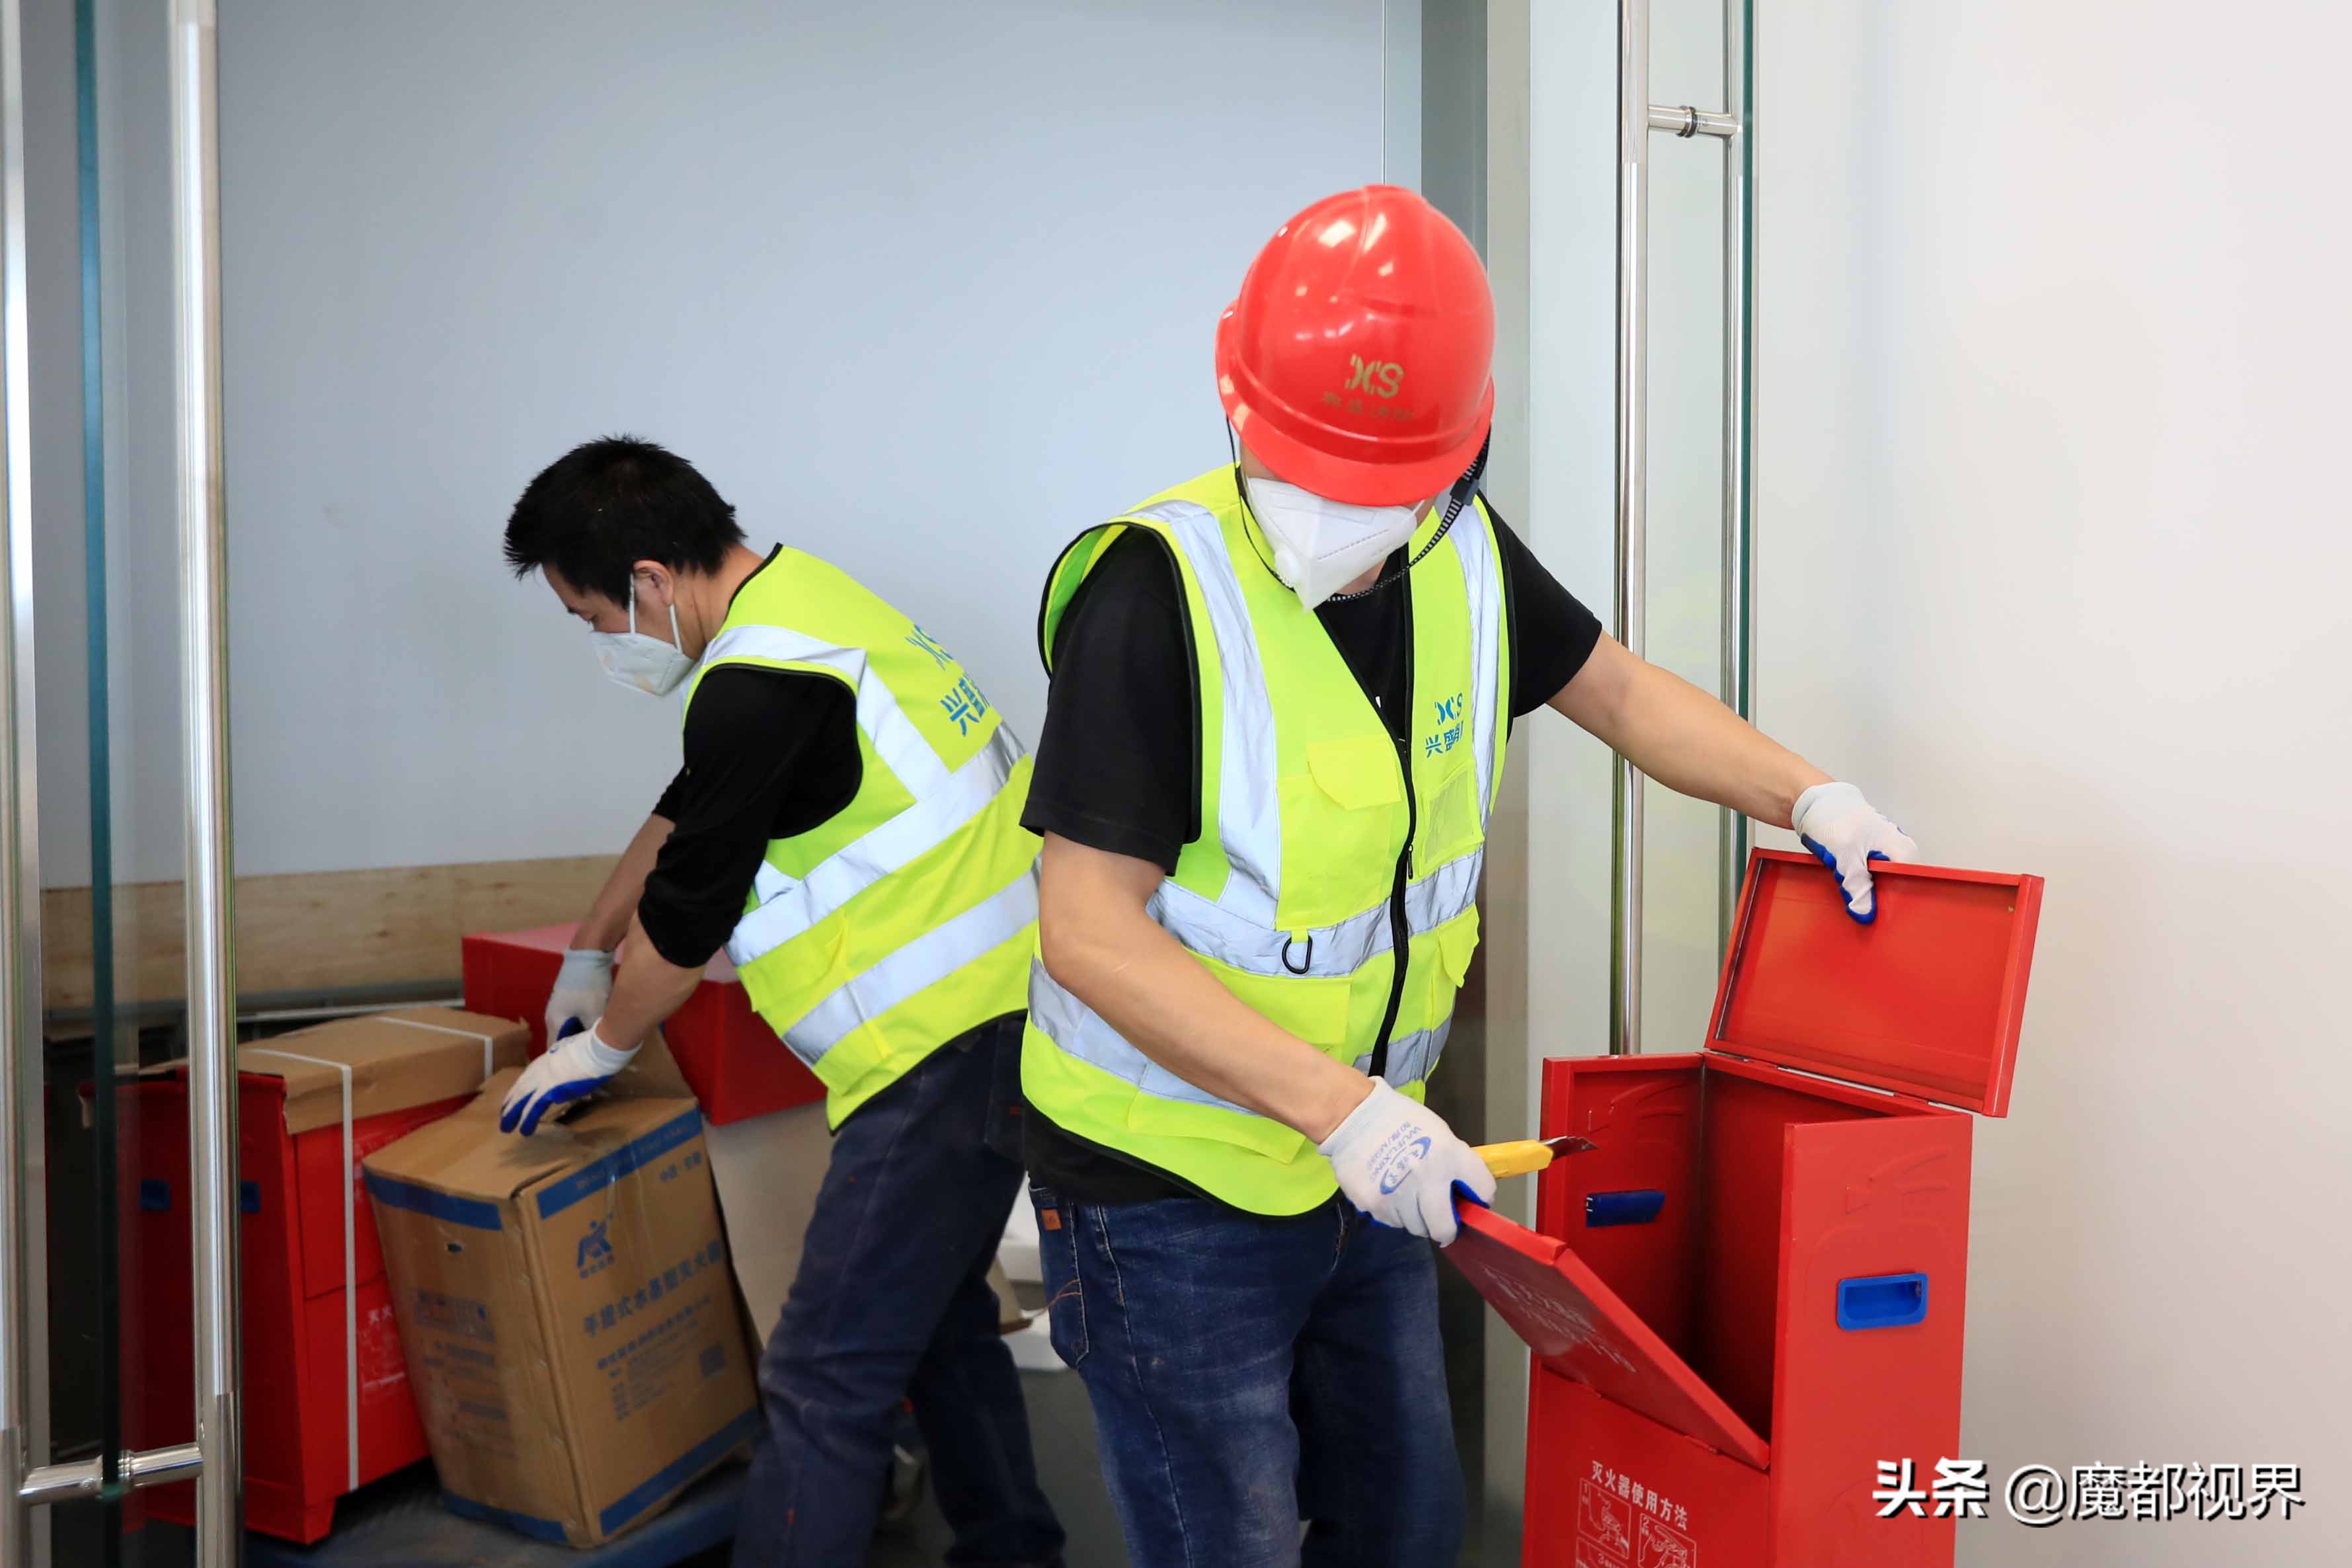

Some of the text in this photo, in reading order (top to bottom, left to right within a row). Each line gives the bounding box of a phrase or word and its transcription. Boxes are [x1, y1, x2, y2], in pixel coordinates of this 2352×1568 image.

[1590, 1459, 1688, 1531] 灭火器使用方法
